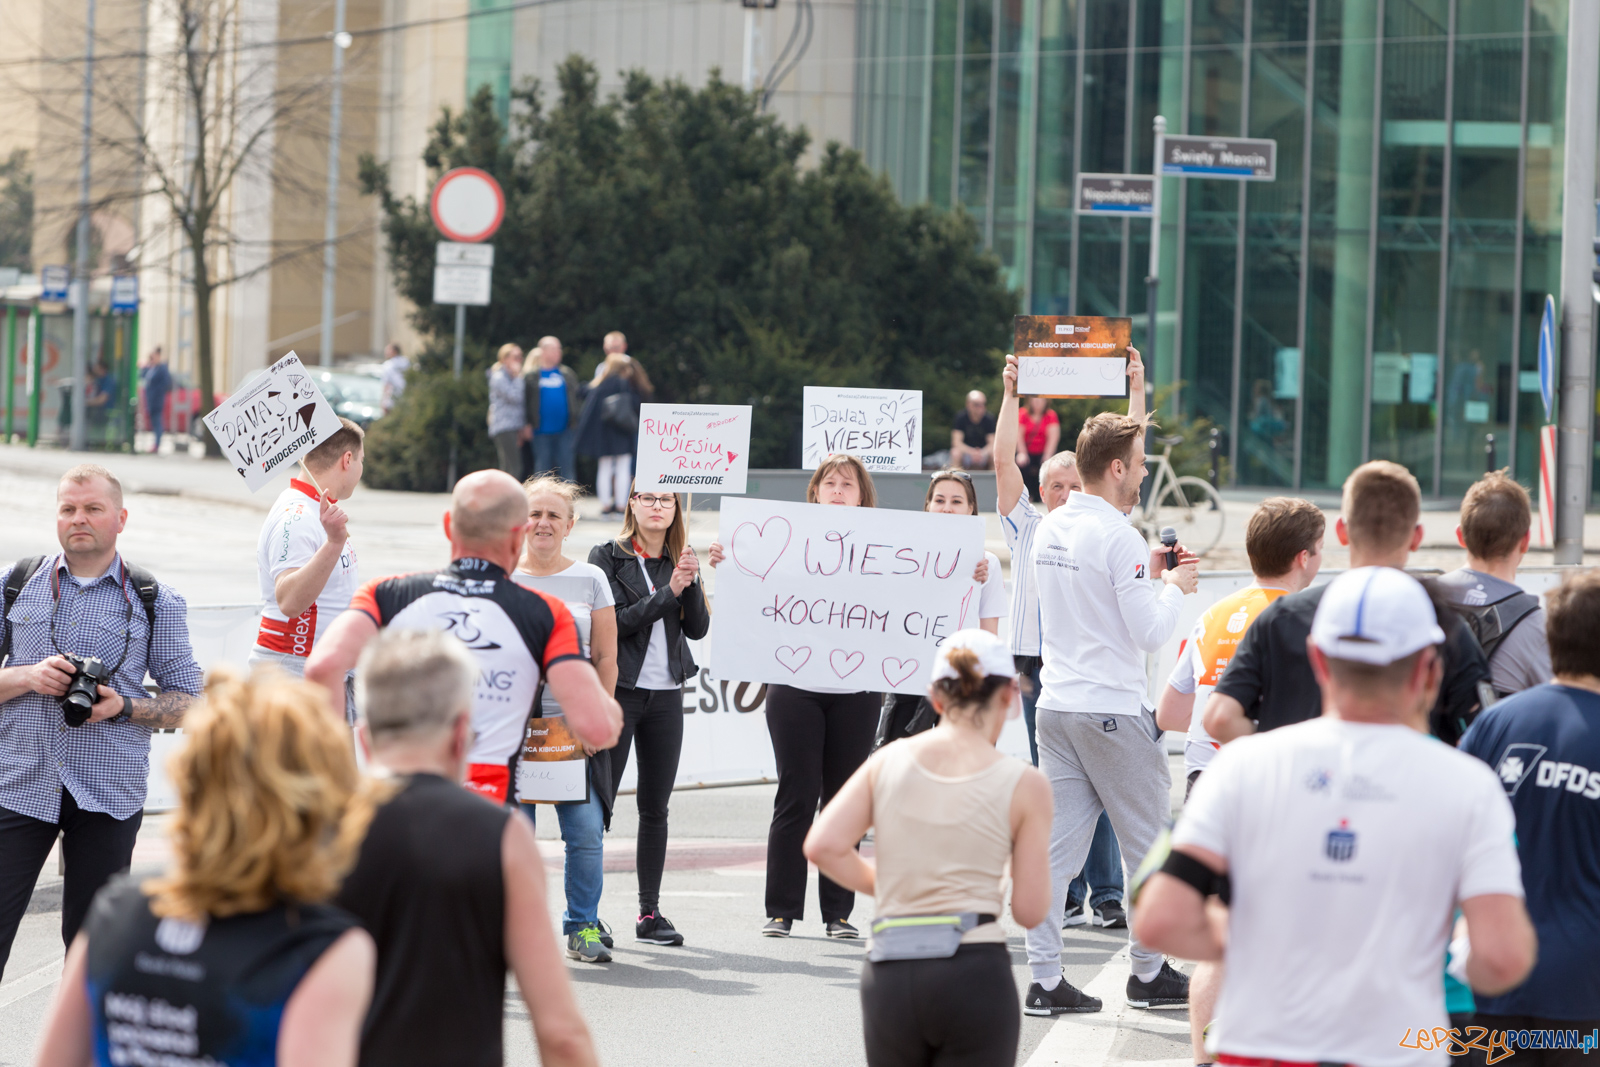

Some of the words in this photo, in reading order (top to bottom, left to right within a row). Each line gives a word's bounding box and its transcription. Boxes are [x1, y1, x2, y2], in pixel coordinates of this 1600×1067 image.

[262, 427, 317, 473] BRIDGESTONE
[658, 474, 724, 485] BRIDGESTONE
[459, 557, 489, 572] 2017
[804, 529, 962, 579] WIESIU
[762, 594, 889, 633] KOCHAM
[538, 744, 576, 753] KIBICUJEMY
[1535, 759, 1600, 800] DFDS
